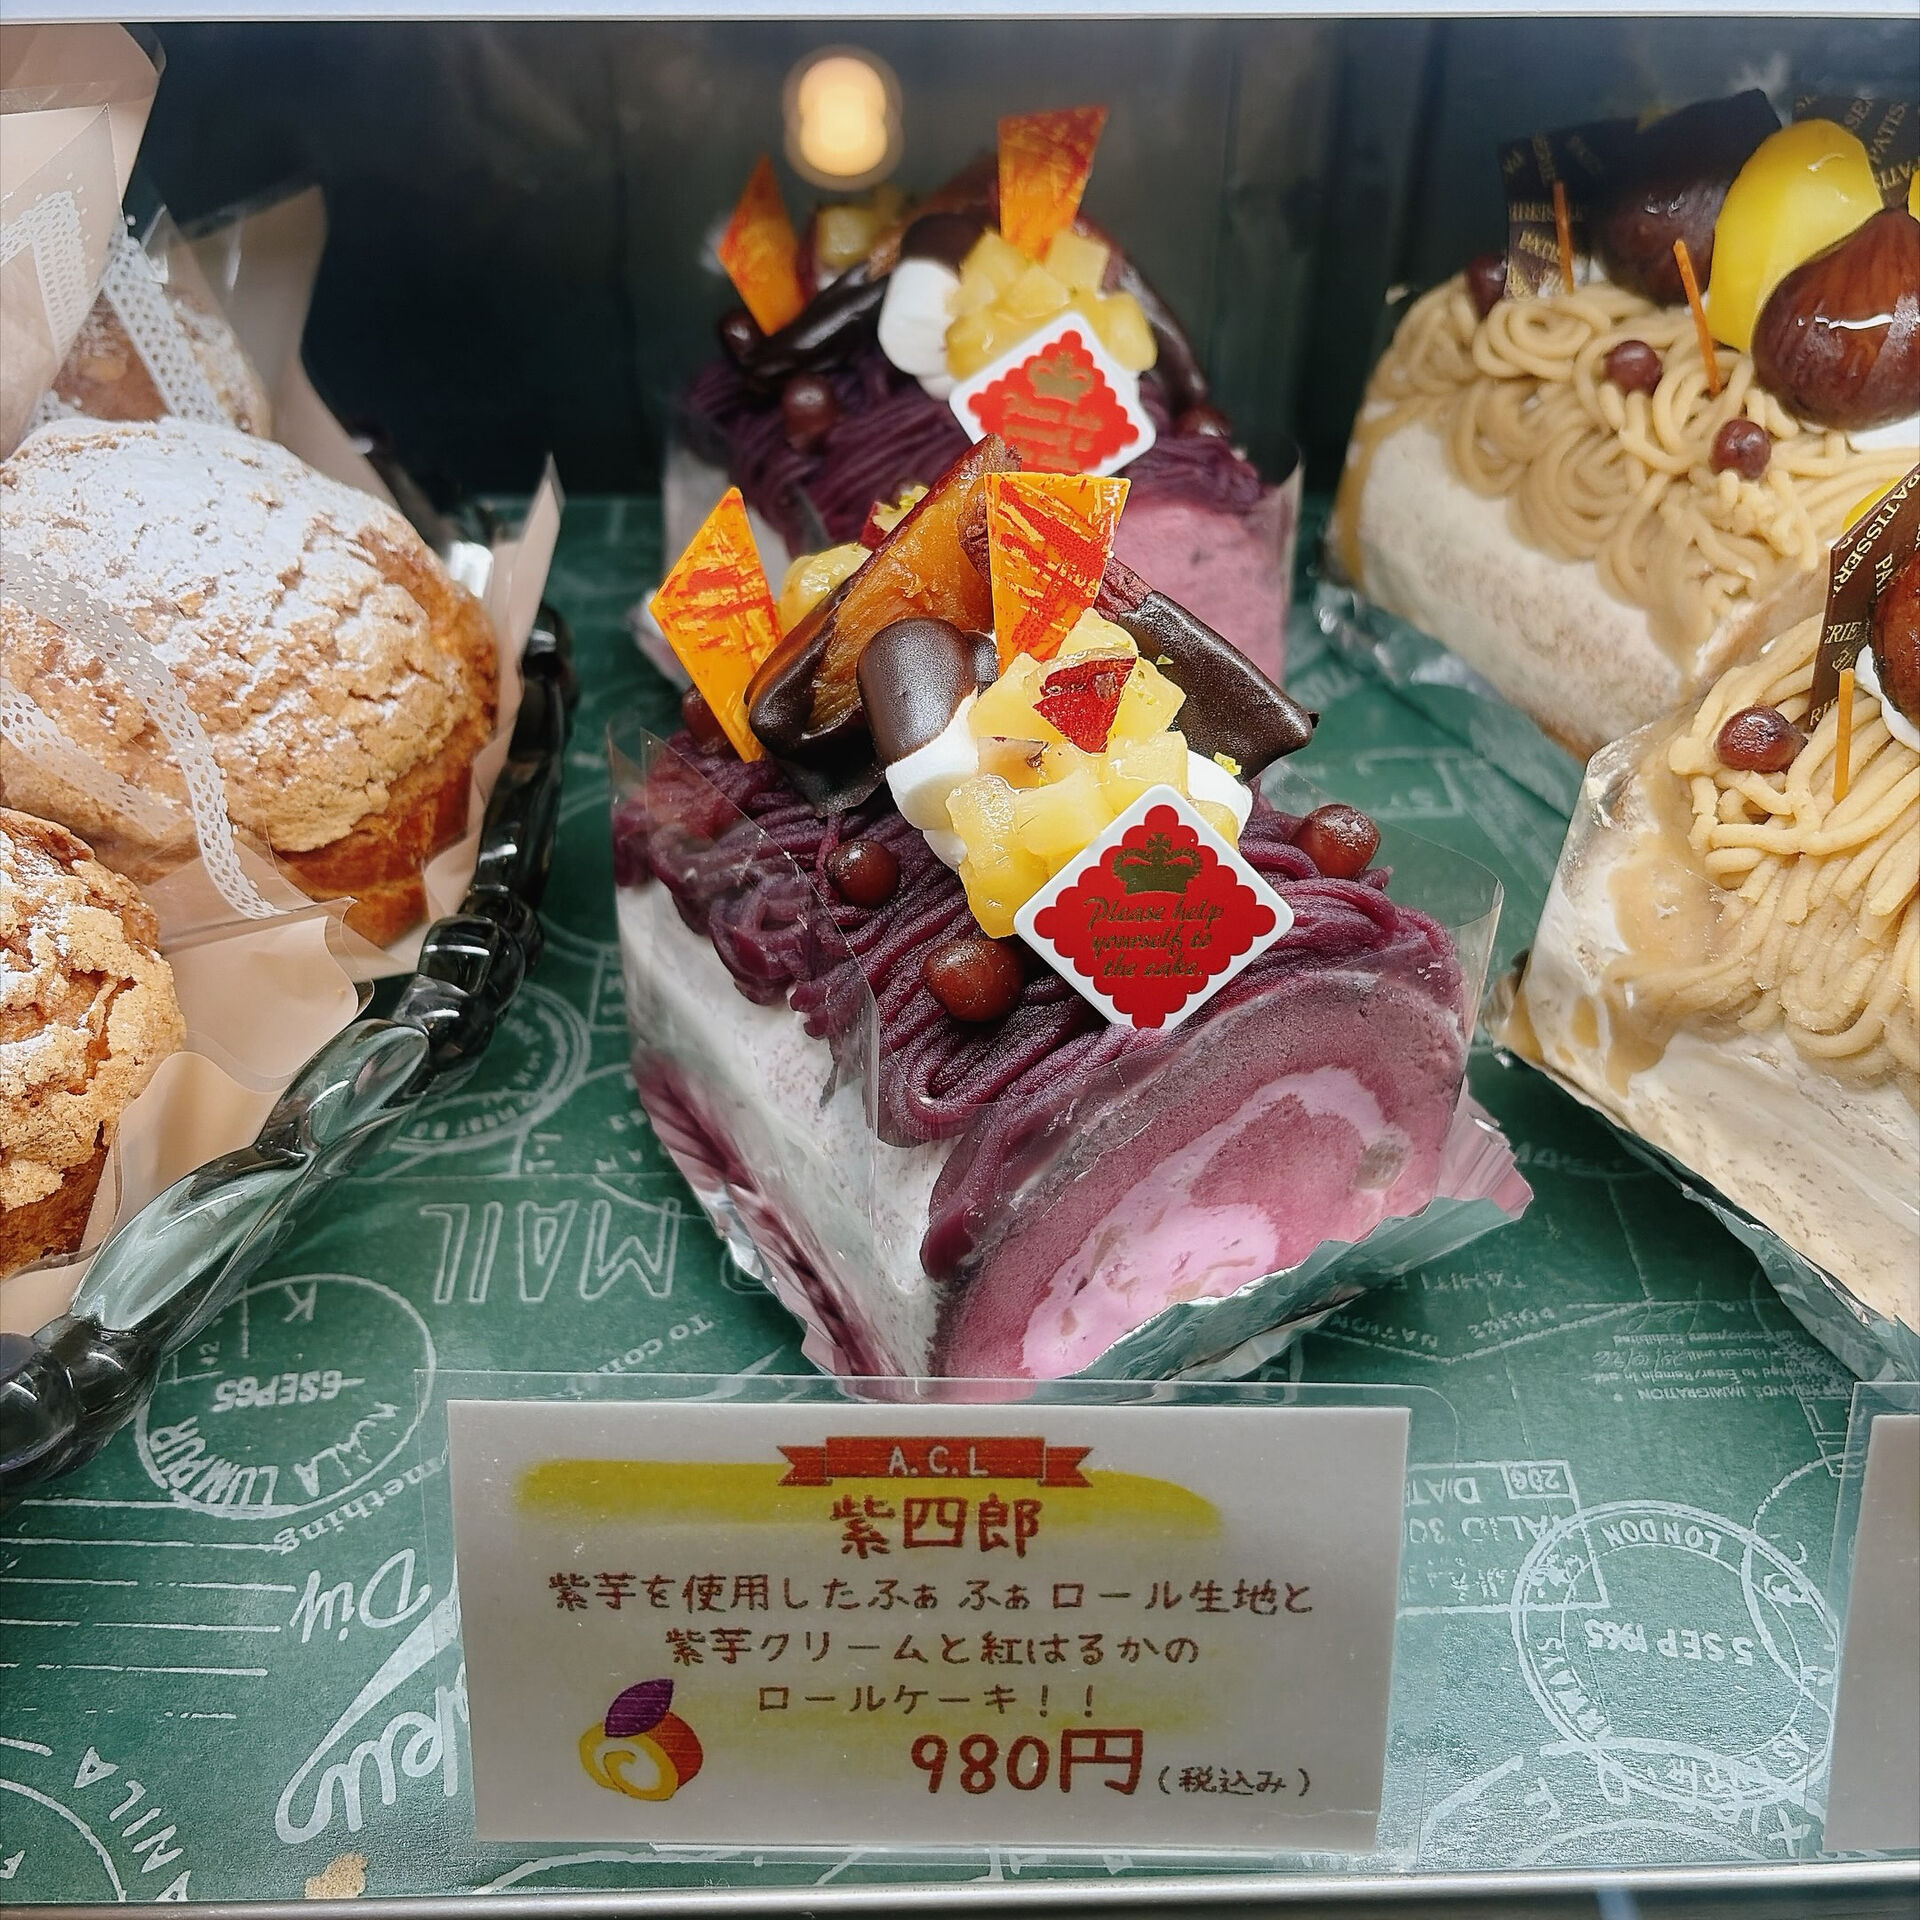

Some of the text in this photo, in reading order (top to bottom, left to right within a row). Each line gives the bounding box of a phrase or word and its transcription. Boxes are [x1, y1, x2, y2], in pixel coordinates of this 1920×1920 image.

[1084, 896, 1224, 931] Please help
[1092, 924, 1212, 959] yourself to
[1103, 952, 1203, 978] the cake.
[889, 1445, 989, 1477] A.C.L
[829, 1492, 1044, 1560] 紫四郎
[1602, 1517, 1722, 1556] LONDON
[665, 1627, 1200, 1667] 紫芋クリームと紅はるかの
[911, 1728, 1312, 1798] 980円 （税込み）
